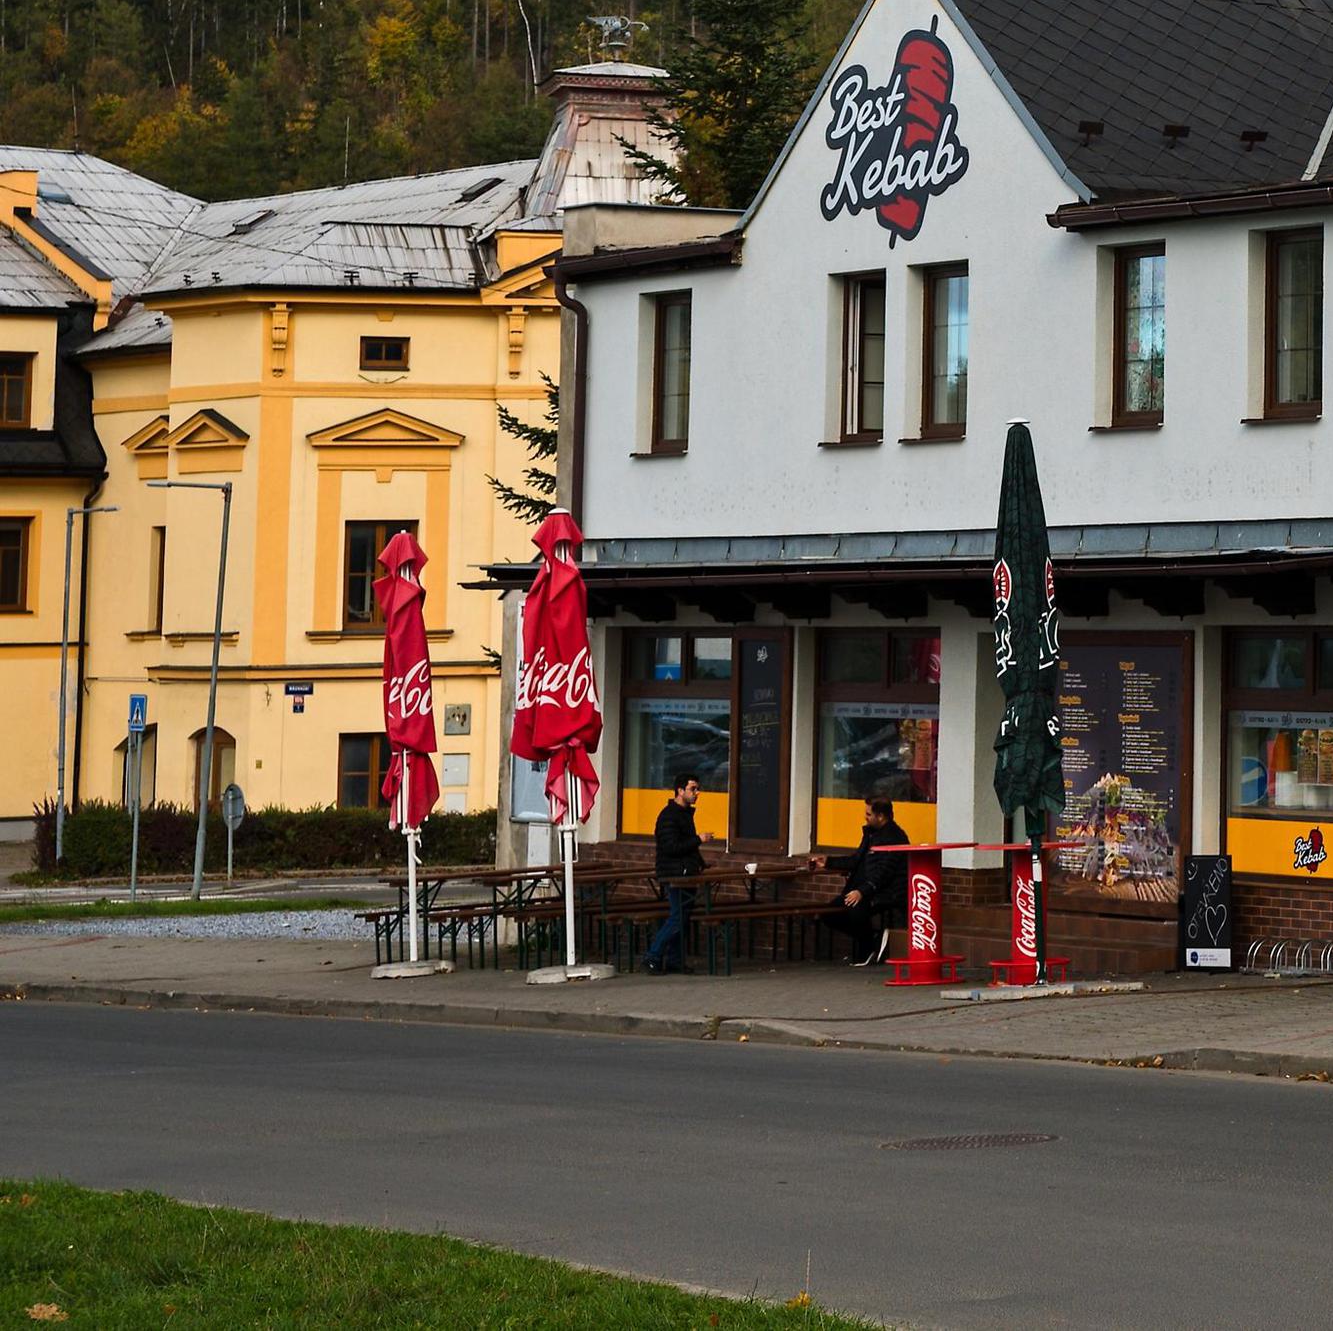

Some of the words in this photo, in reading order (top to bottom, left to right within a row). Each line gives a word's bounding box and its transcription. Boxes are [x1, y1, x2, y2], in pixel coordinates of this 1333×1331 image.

[831, 74, 904, 139] Best
[826, 114, 963, 211] Kebab
[1294, 846, 1326, 867] Kebab
[1295, 838, 1312, 853] Best
